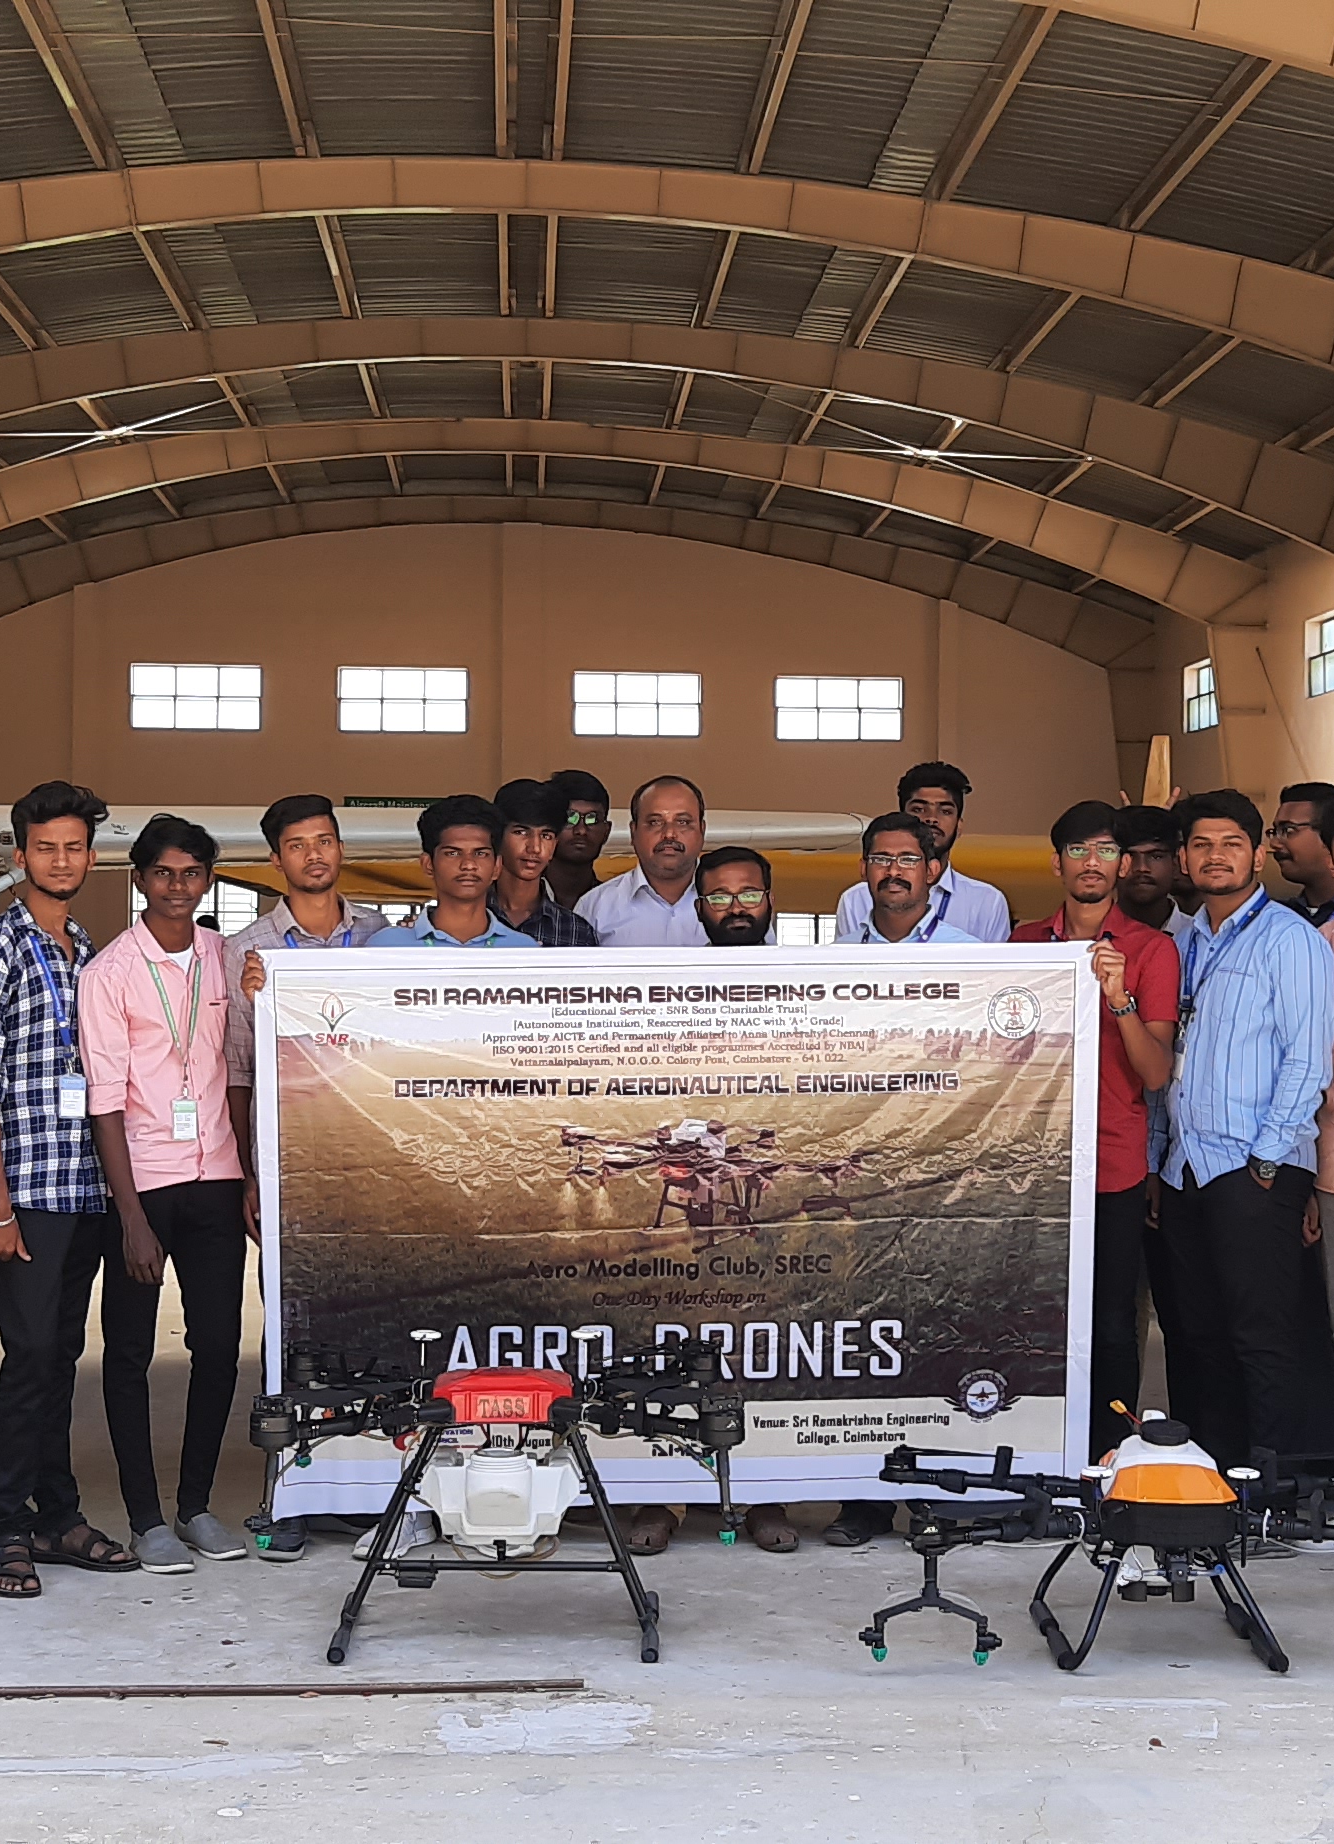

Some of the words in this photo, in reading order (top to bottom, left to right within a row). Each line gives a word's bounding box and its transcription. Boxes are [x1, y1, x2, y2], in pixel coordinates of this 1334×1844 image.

[393, 987, 437, 1006] SRI
[444, 985, 643, 1006] RAMAKRISHNA
[648, 984, 826, 1003] ENGINEERING
[832, 982, 961, 1001] COLLEGE
[620, 1006, 656, 1016] Service
[667, 1005, 689, 1015] SNR
[692, 1005, 717, 1015] Sons
[720, 1004, 773, 1014] Charitable
[647, 1018, 712, 1028] Reaccredited
[715, 1017, 728, 1028] by
[731, 1017, 760, 1027] NAAC
[763, 1016, 786, 1026] with
[314, 1032, 350, 1047] SNR
[537, 1032, 550, 1043] by
[552, 1032, 586, 1042] AICTE
[589, 1031, 609, 1041] and
[611, 1031, 677, 1041] Permanently
[679, 1030, 726, 1040] Affiliated
[728, 1030, 738, 1039] to
[517, 1045, 574, 1055] 9001:2015
[576, 1043, 621, 1053] Certified
[623, 1043, 644, 1052] and
[646, 1043, 659, 1052] all
[662, 1042, 698, 1054] eligible
[701, 1043, 765, 1053] programmes
[768, 1041, 821, 1051] Accredited
[824, 1041, 837, 1052] by
[666, 1055, 703, 1066] Colony
[732, 1054, 792, 1064] Coimbatore
[801, 1053, 820, 1063] 641
[393, 1078, 562, 1098] DEPARTMENT
[567, 1077, 600, 1097] OF
[605, 1075, 790, 1096] AERONAUTICAL
[795, 1072, 959, 1094] ENGINEERING
[526, 1259, 578, 1279] Aero
[585, 1256, 700, 1281] Modelling
[708, 1255, 766, 1279] Club,
[773, 1254, 832, 1275] SREC
[626, 1290, 661, 1310] Day
[664, 1288, 743, 1311] Workshop
[477, 1397, 526, 1419] TASS
[753, 1415, 790, 1429] Venue:
[793, 1415, 809, 1428] Sri
[812, 1413, 884, 1427] Ramakrishna
[887, 1412, 950, 1427] Engineering
[843, 1430, 906, 1443] Coimbatore
